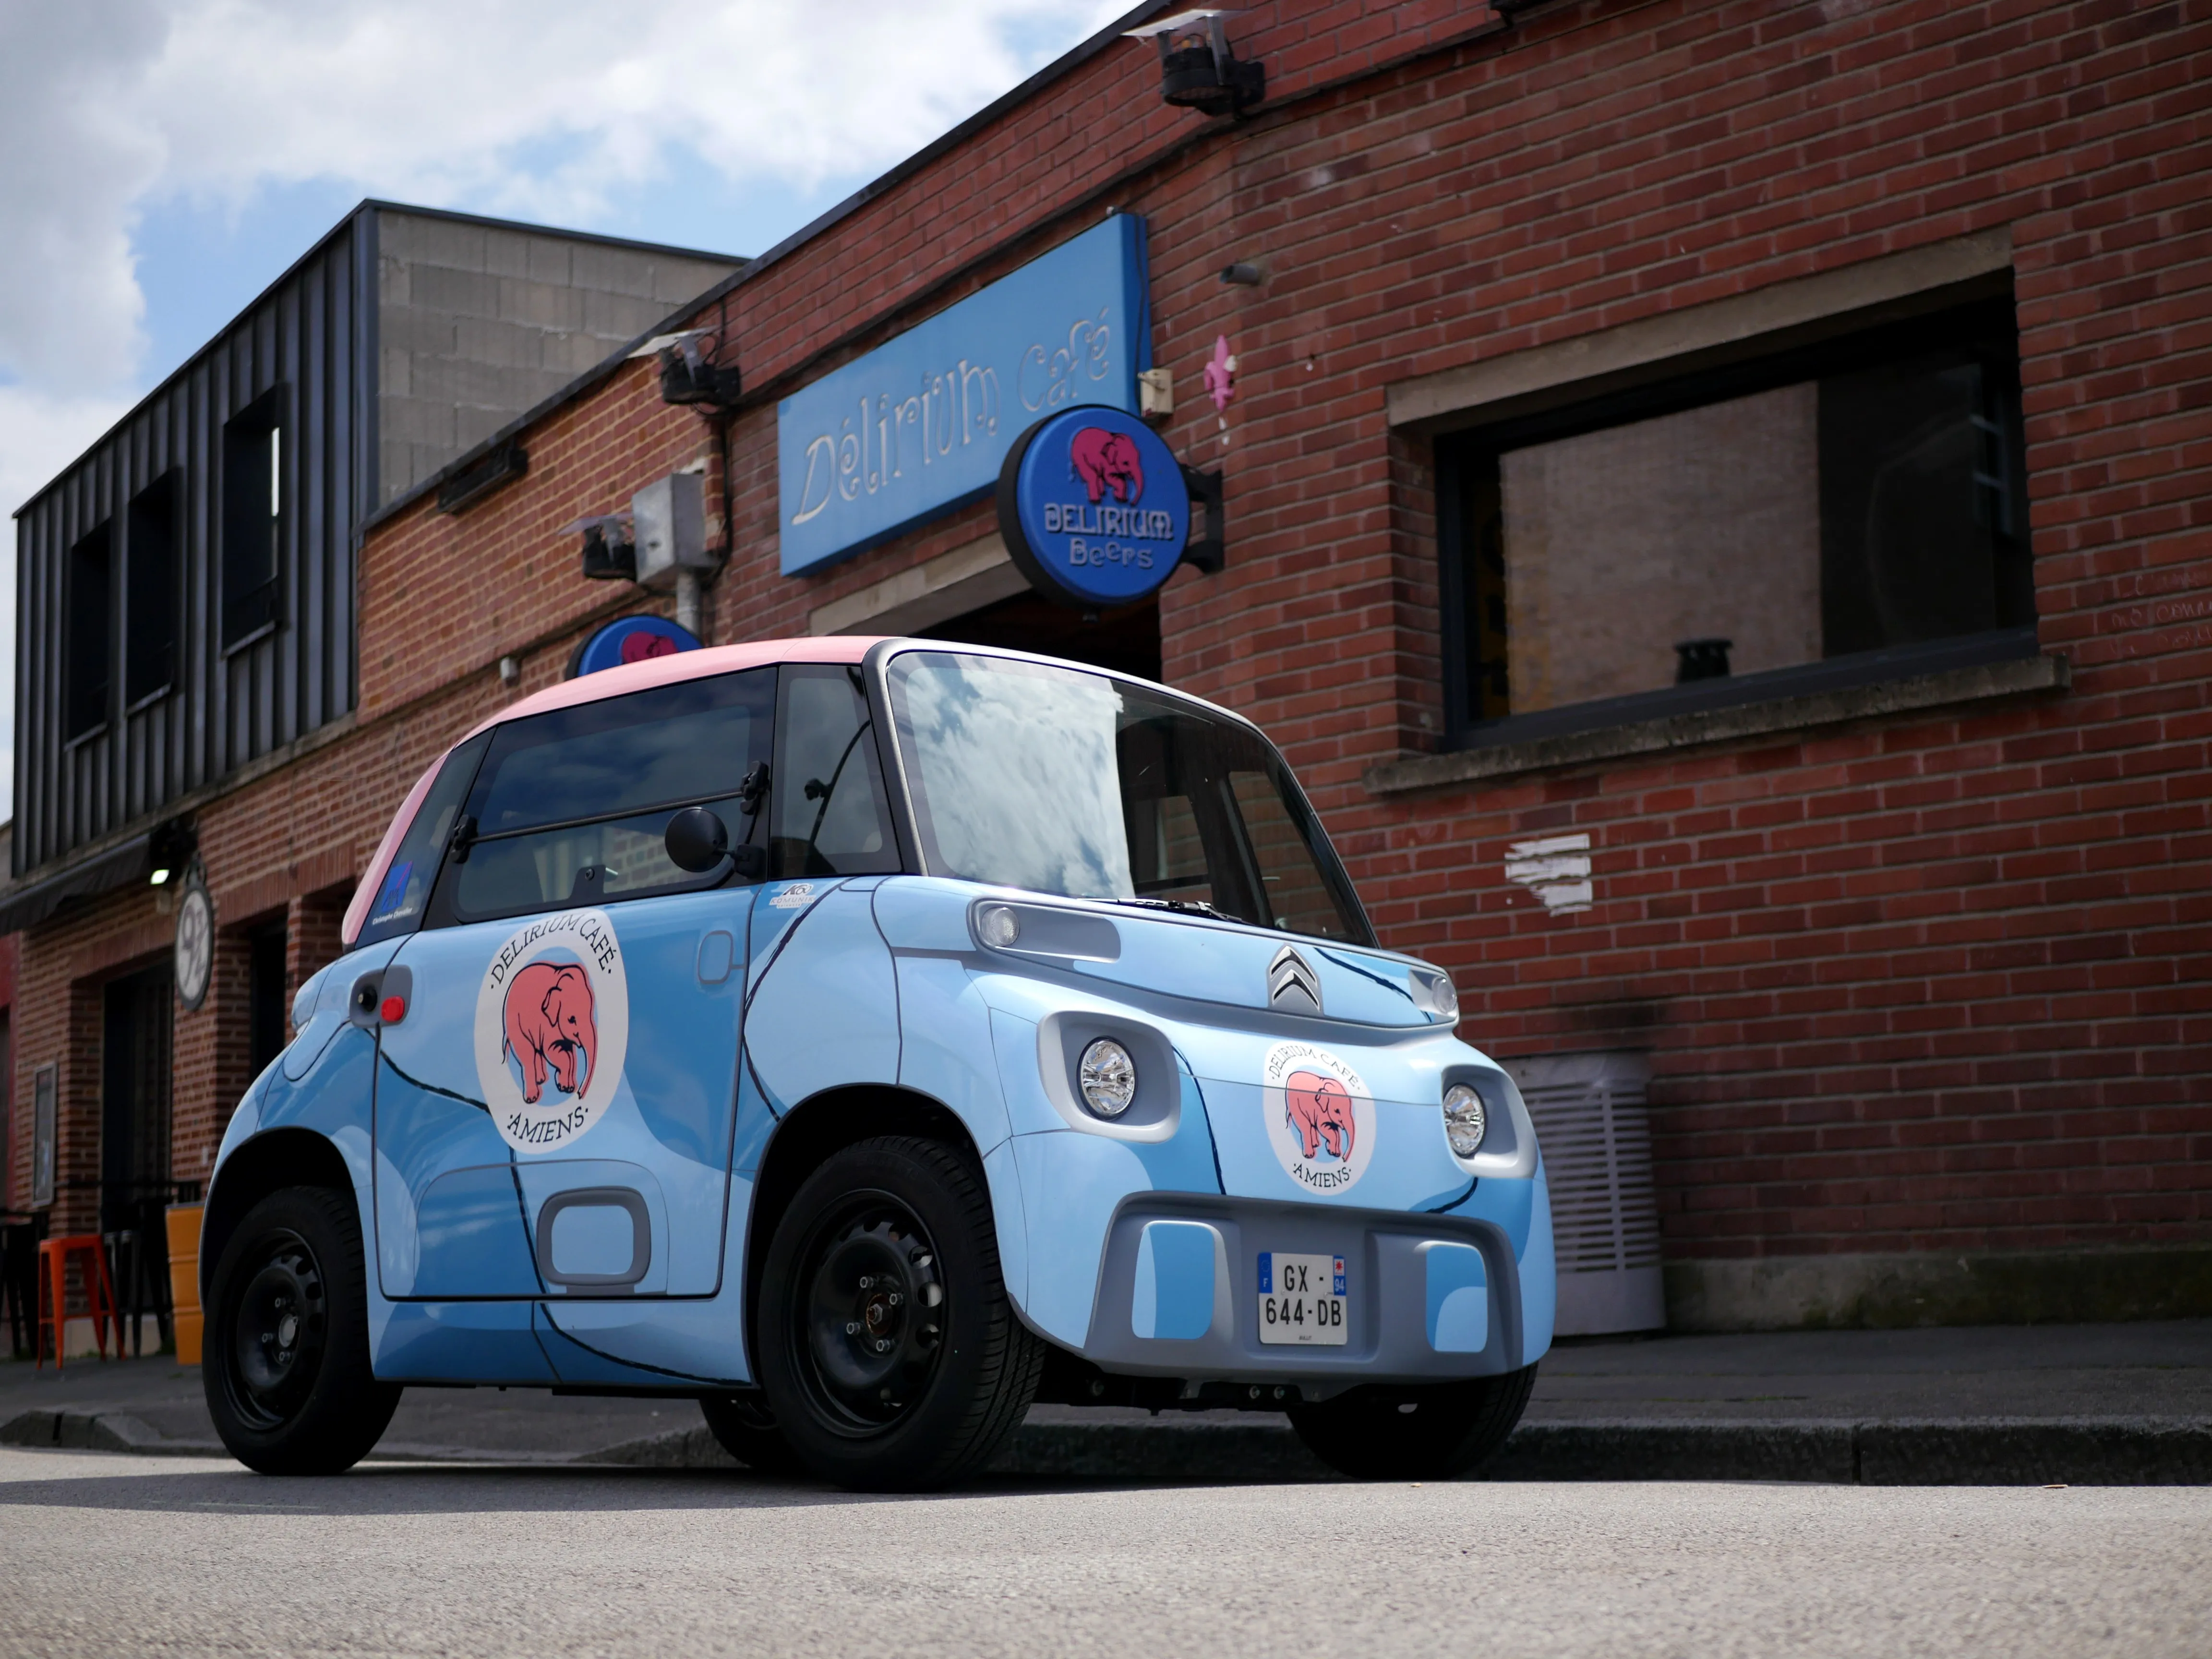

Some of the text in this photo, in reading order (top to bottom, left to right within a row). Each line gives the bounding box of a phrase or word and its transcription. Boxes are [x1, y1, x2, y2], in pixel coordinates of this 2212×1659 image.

[792, 306, 1110, 526] Délirium Café
[1044, 503, 1174, 540] DELIRIUM
[1070, 537, 1154, 569] Beers
[491, 914, 616, 984] DELIRIUM CAFÉ
[1269, 1046, 1358, 1087] DELIRIUM CAFÉ
[507, 1106, 584, 1143] AMIENS
[1293, 1163, 1349, 1187] AMIENS
[1263, 1278, 1268, 1287] F
[1334, 1278, 1344, 1292] 94
[1266, 1298, 1341, 1326] 644-DB
